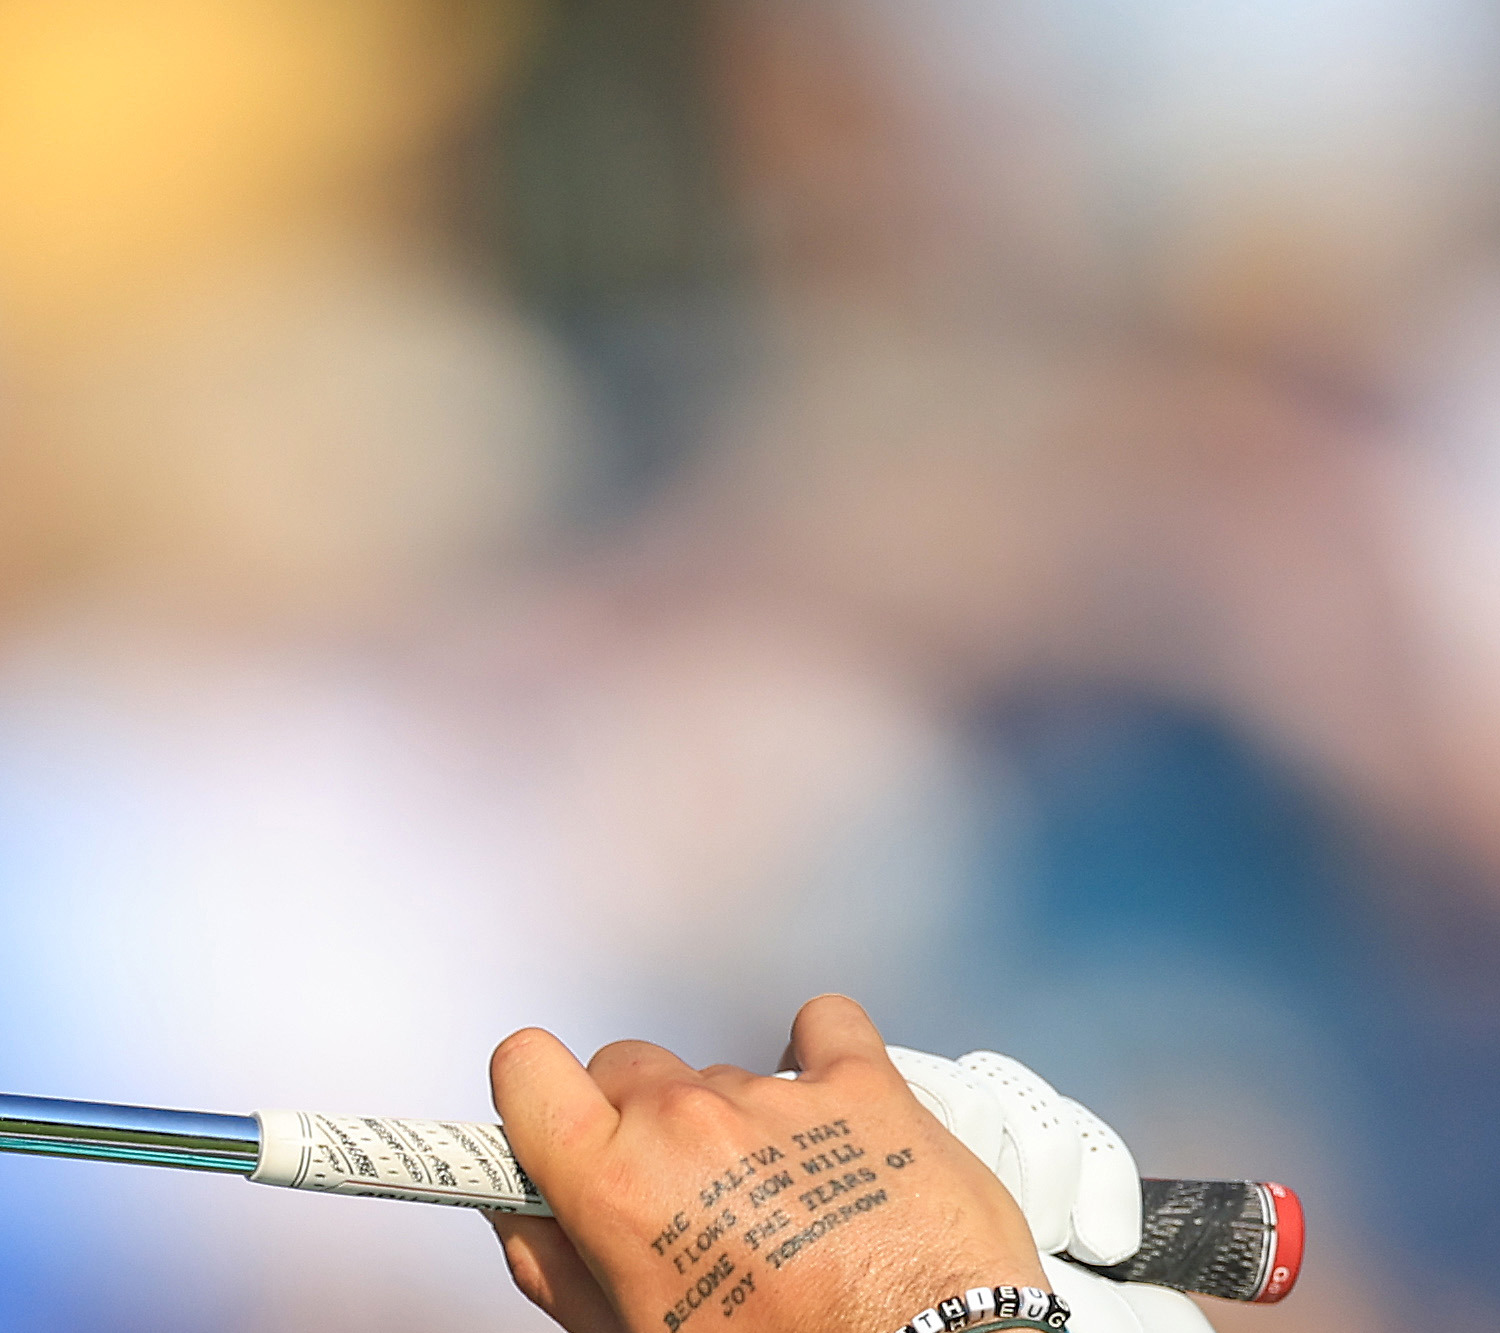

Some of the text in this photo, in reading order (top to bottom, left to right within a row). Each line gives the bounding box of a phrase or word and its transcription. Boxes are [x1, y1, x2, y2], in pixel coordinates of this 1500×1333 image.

[651, 1119, 851, 1256] THE SALIVA THAT
[673, 1143, 865, 1275] FLOWS NOW WILL
[721, 1188, 888, 1317] JOY TOMORROW
[743, 1209, 791, 1251] THE
[798, 1167, 877, 1212] TEARS
[885, 1147, 915, 1170] OF
